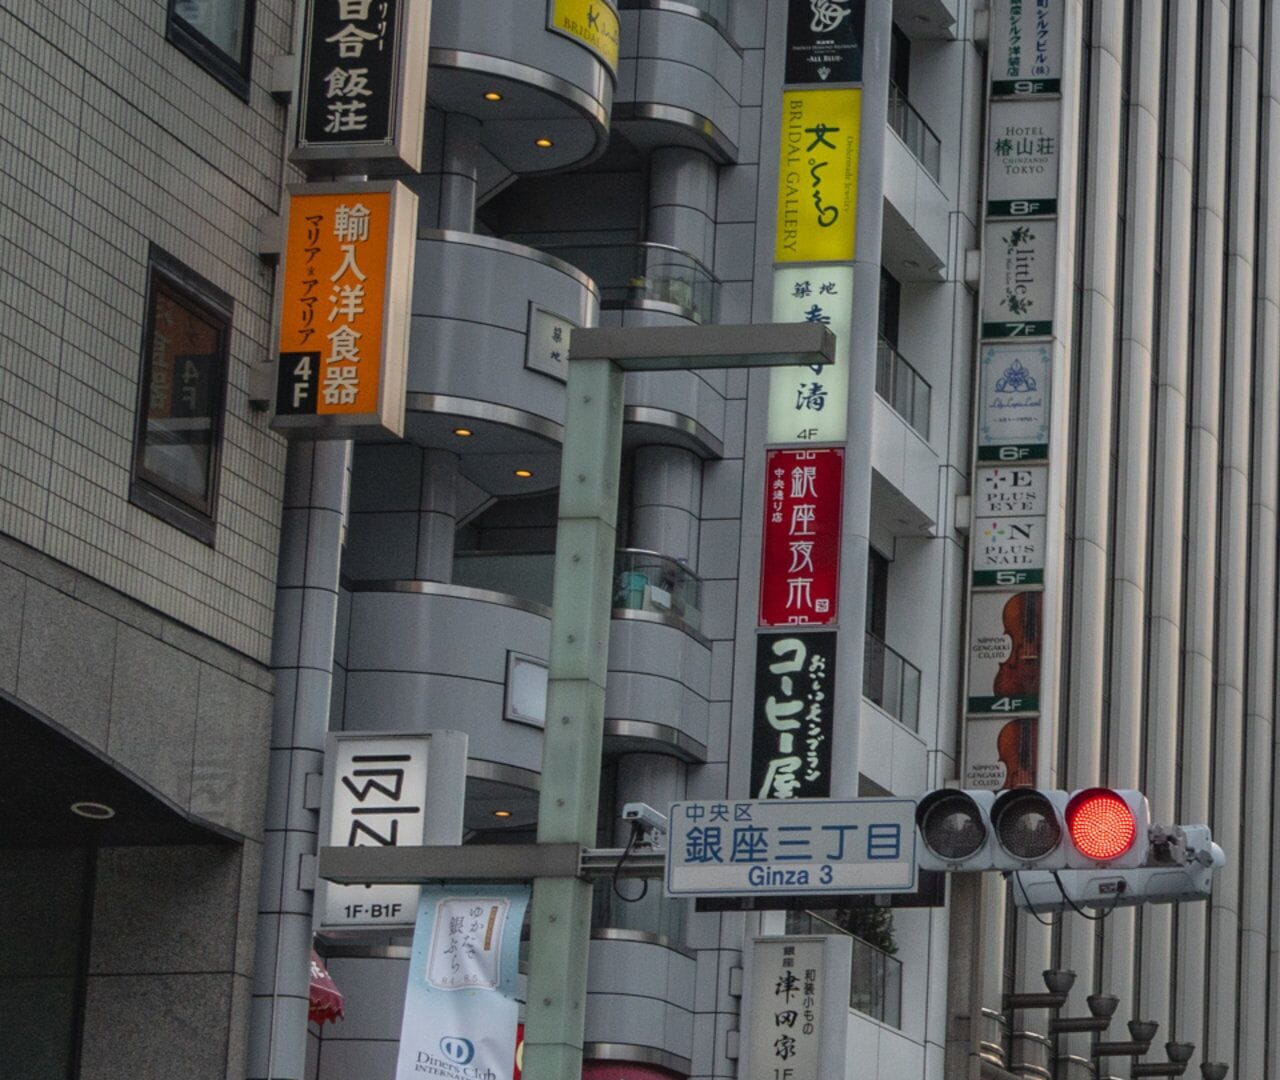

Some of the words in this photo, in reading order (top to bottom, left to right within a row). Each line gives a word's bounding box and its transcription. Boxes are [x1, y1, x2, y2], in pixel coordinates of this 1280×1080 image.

[1014, 81, 1044, 94] 9F
[788, 99, 803, 164] BRIDAL
[1006, 126, 1045, 136] HOTEL
[995, 137, 1055, 156] 椿山荘
[1006, 165, 1044, 176] TOKYO
[782, 169, 800, 252] GALLERY
[1010, 201, 1041, 214] 8F
[323, 202, 371, 406] 輸入洋食器
[1006, 323, 1037, 337] 7F
[797, 429, 819, 440] 4F
[1000, 446, 1031, 460] 6F
[987, 492, 1037, 502] PLUS
[990, 502, 1034, 512] EYE
[786, 466, 818, 609] 銀座夜市
[986, 546, 1035, 555] PLUS
[987, 555, 1033, 565] NAIL
[996, 571, 1028, 585] 5F
[991, 697, 1022, 711] 4F
[758, 637, 808, 800] コーヒー屋
[686, 803, 754, 823] 中央区
[684, 824, 901, 864] 銀座三丁目
[748, 865, 811, 887] Ginza
[819, 865, 834, 885] 3
[416, 1051, 462, 1079] Diners
[774, 1069, 795, 1080] 1F
